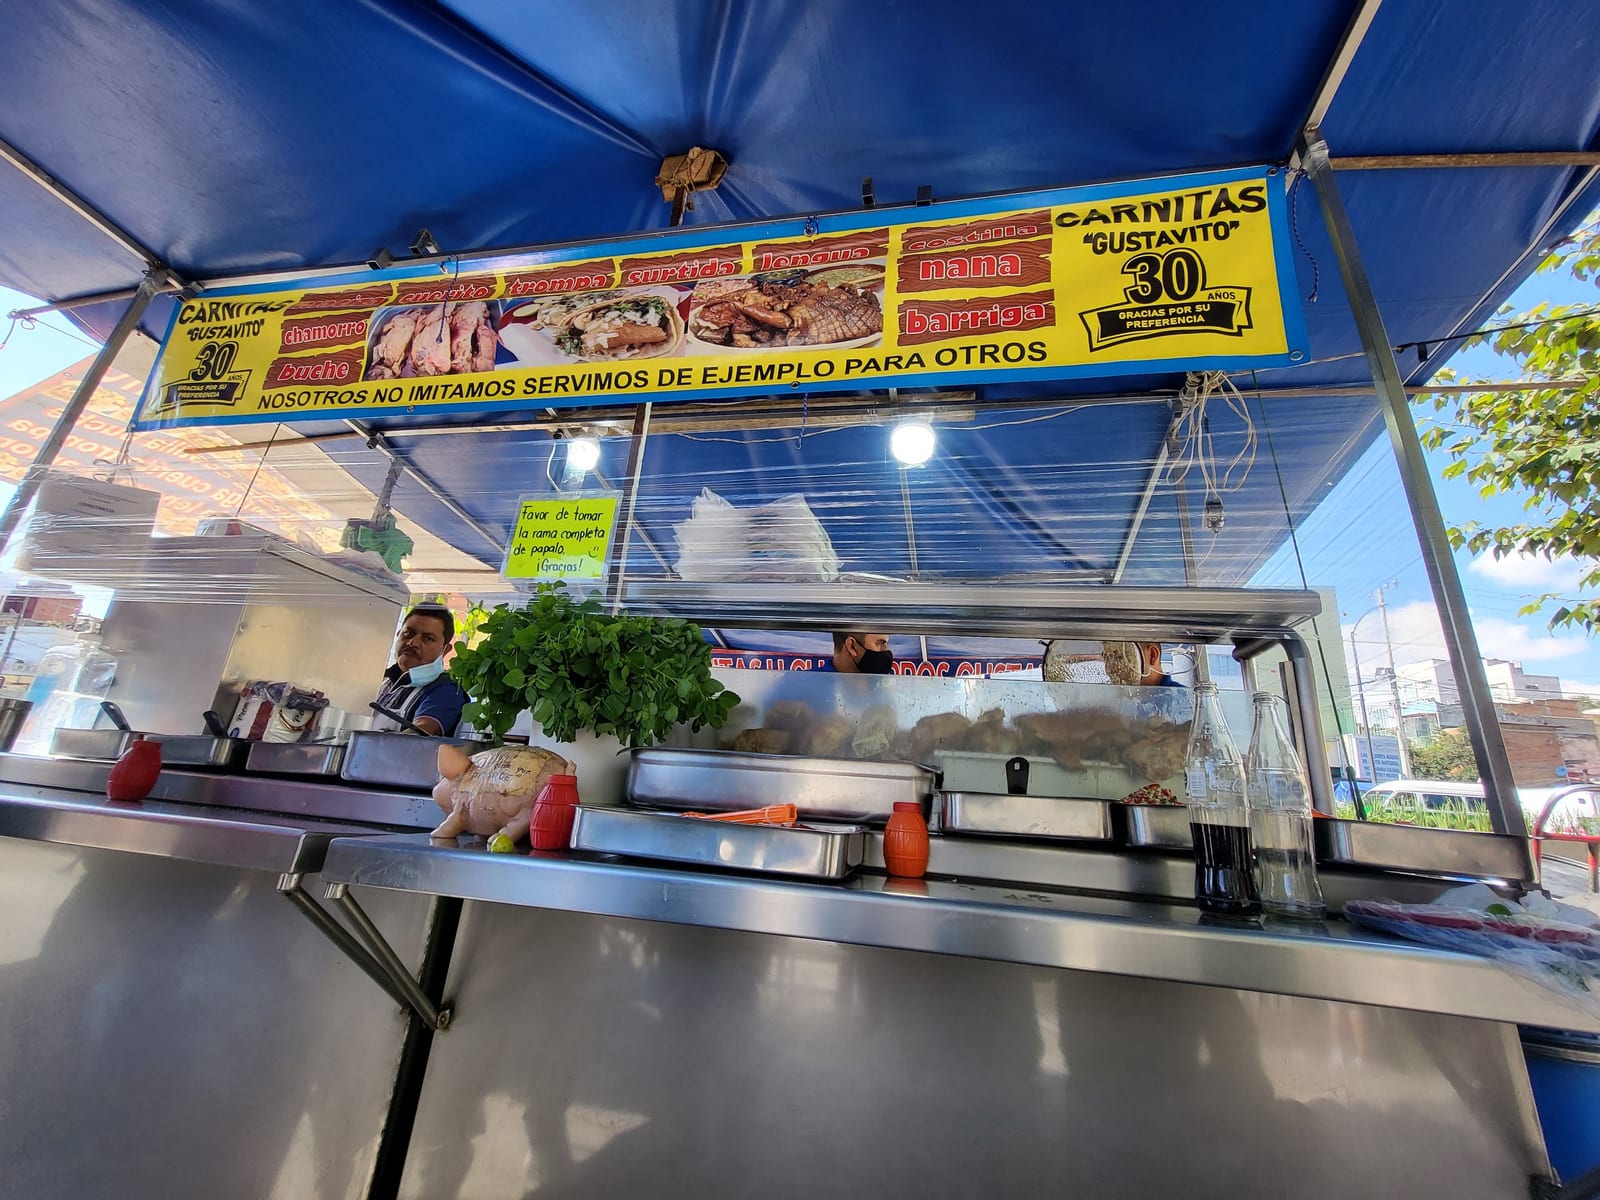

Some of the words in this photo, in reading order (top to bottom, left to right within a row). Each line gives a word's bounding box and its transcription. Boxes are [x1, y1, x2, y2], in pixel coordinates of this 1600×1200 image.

[1055, 186, 1267, 228] CARNITAS
[908, 223, 1038, 250] costilla
[627, 257, 736, 285] surtida
[760, 246, 871, 271] lengua
[919, 252, 1022, 280] nana
[508, 273, 608, 294] trompa
[1122, 248, 1204, 304] 30
[1207, 289, 1236, 300] AÑOS
[178, 300, 295, 325] CARNITAS
[905, 303, 1046, 335] barriga
[1118, 308, 1166, 320] GRACIAS
[1168, 305, 1193, 315] POR
[1195, 303, 1211, 312] SU
[1126, 314, 1206, 329] PREFERENCIA
[284, 320, 366, 346] chamorro
[191, 341, 239, 381] 30
[278, 360, 350, 382] buche
[257, 389, 369, 411] NOSOTROS
[372, 386, 404, 404] NO
[408, 380, 516, 402] IMITAMOS
[522, 369, 650, 395] SERVIMOS
[657, 367, 693, 387] DE
[701, 359, 836, 385] EJEMPLO
[844, 351, 926, 375] PARA
[934, 341, 1048, 366] OTROS
[521, 505, 549, 520] Favor
[555, 507, 569, 520] de
[574, 506, 604, 521] tomar
[518, 526, 529, 539] la
[532, 529, 558, 539] rama
[560, 526, 605, 542] completa
[513, 544, 526, 555] de
